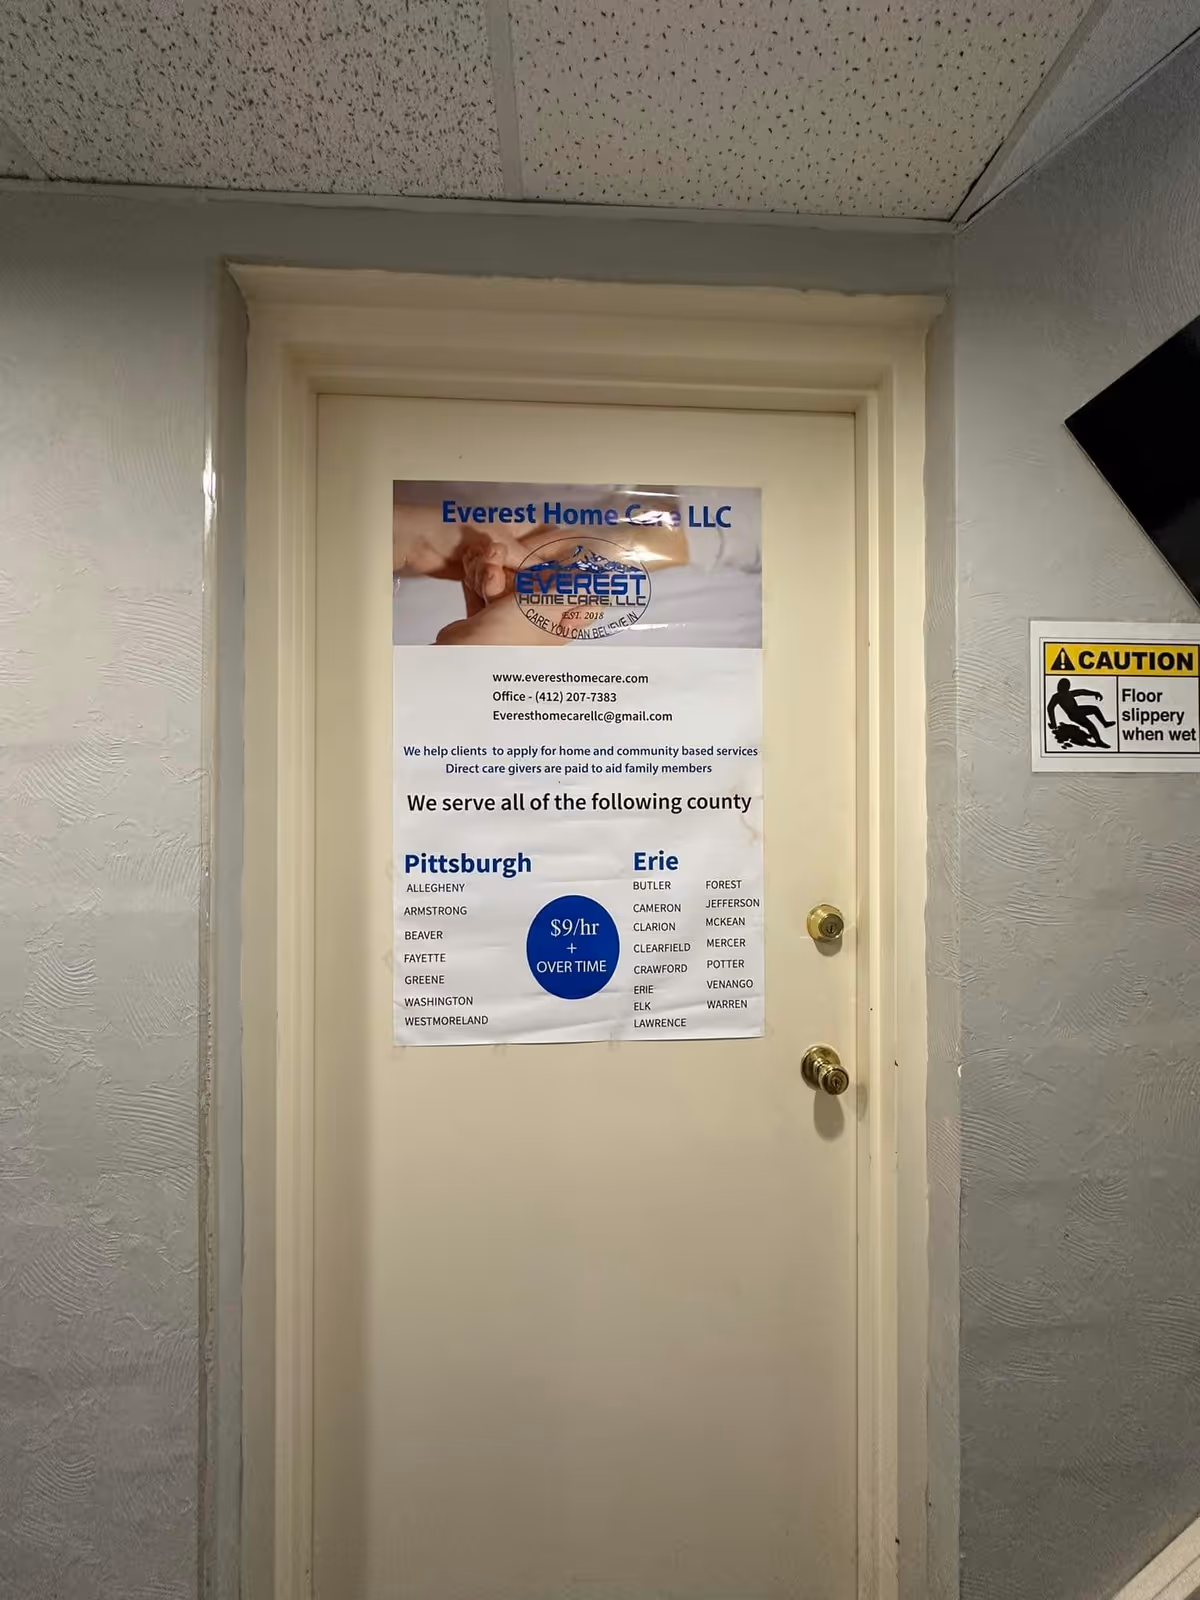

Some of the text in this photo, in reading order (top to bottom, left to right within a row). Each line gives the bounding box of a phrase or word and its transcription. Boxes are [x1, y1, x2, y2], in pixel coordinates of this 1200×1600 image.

[442, 500, 732, 528] Everest Home Ce LLC
[516, 571, 647, 596] EVEREST
[519, 594, 647, 607] HOME CARE, LLC
[561, 611, 605, 620] EST. 2018
[525, 608, 550, 631] CARE
[551, 622, 570, 638] YOU
[571, 628, 591, 640] CAN
[626, 610, 640, 625] IN
[1078, 650, 1193, 671] CAUTION
[492, 671, 649, 685] www.everesthomecare.com
[492, 690, 526, 703] Office
[535, 690, 563, 704] (412)
[566, 691, 617, 703] 207-7383
[1121, 688, 1163, 703] Floor
[492, 709, 673, 723] Everesthomecarellc@gmail.com
[1121, 708, 1185, 725] slippery
[1122, 728, 1197, 741] when wet
[403, 746, 758, 758] We help clients to apply for home and community based services
[445, 763, 712, 776] Direct care givers are paid to aid family members
[407, 793, 752, 814] We serve all of the following county
[404, 852, 532, 878] Pittsburgh
[633, 850, 679, 871] Erie
[406, 883, 465, 893] ALLEGHENY
[633, 880, 671, 891] BUTLER
[705, 879, 742, 890] FOREST
[633, 903, 682, 914] CAMERON
[705, 898, 760, 909] JEFFERSON
[404, 905, 468, 916] ARMSTRONG
[550, 918, 600, 937] $9/hr
[633, 921, 676, 932] CLARION
[705, 917, 746, 927] MCKEAN
[404, 930, 443, 941] BEAVER
[633, 942, 691, 953] CLEARFIELD
[706, 937, 746, 948] MERCER
[566, 943, 578, 954] +
[404, 952, 447, 963] FAYETTE
[536, 960, 606, 973] OVER TIME
[633, 963, 688, 975] CRAWFORD
[706, 959, 745, 969] POTTER
[404, 974, 445, 985] GREENE
[706, 979, 754, 990] VENANGO
[633, 984, 655, 995] ERIE
[404, 996, 474, 1008] WASHINGTON
[633, 1001, 652, 1012] ELK
[706, 999, 748, 1010] WARREN
[404, 1016, 489, 1027] WESTMORELAND
[633, 1017, 687, 1028] LAWRENCE
